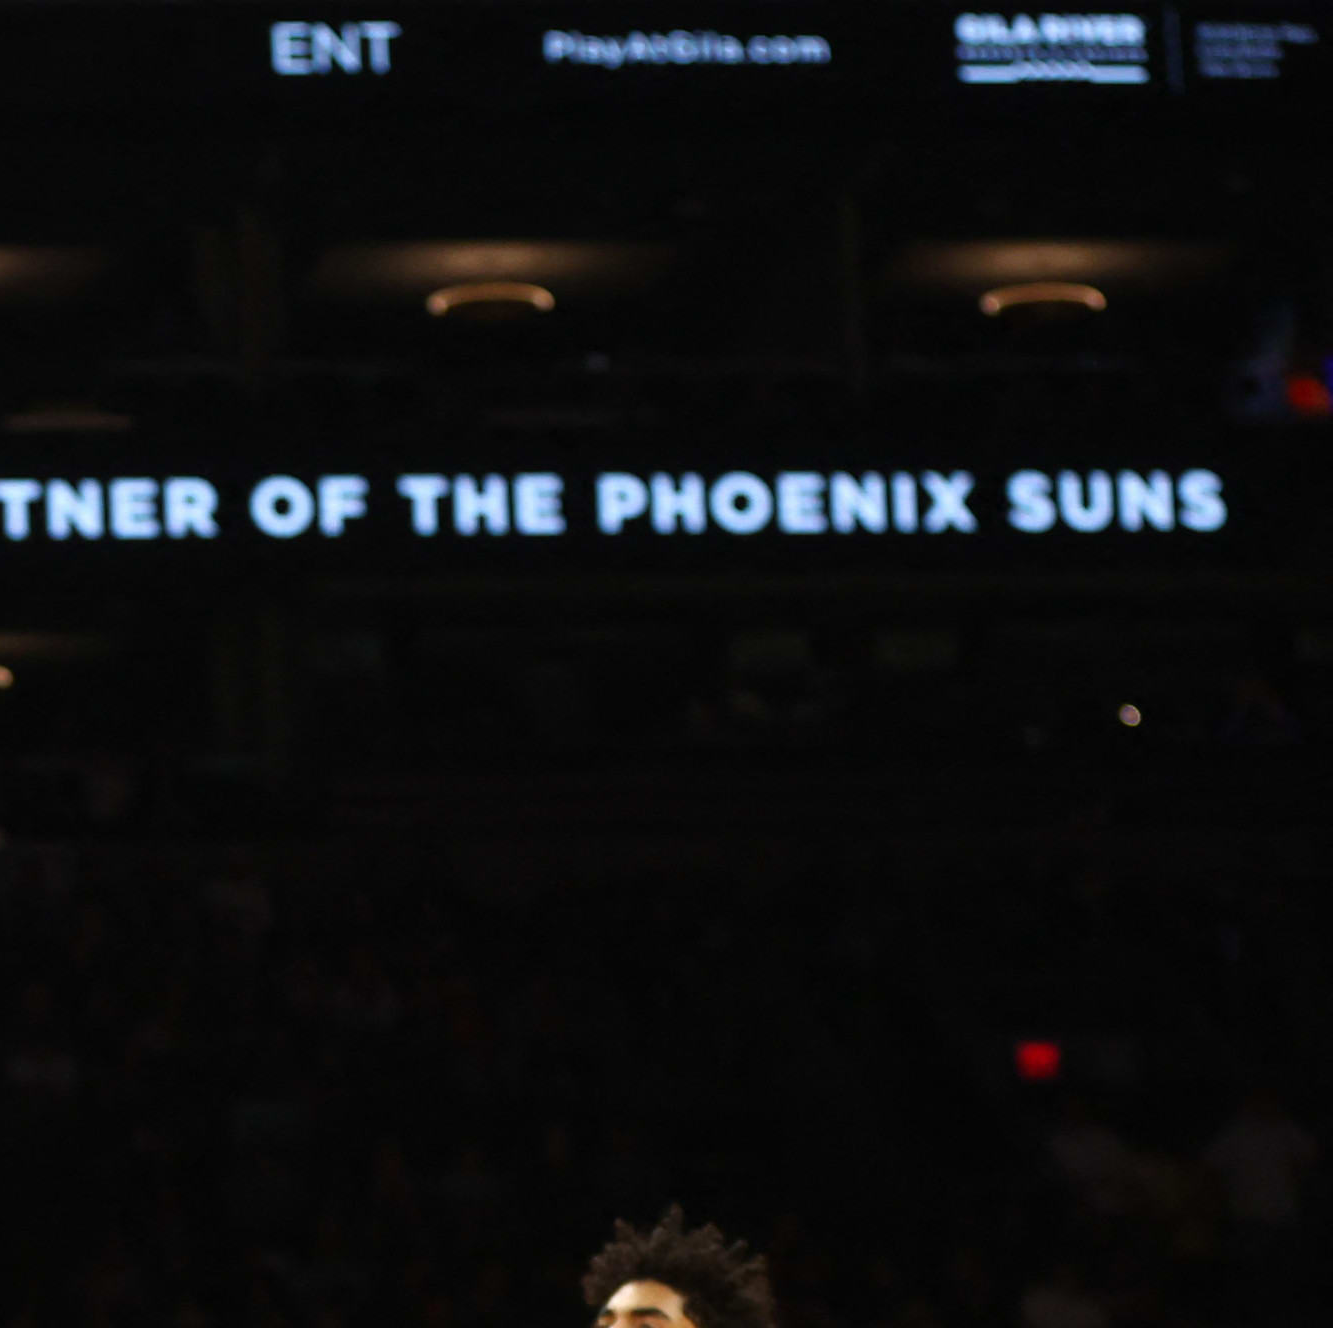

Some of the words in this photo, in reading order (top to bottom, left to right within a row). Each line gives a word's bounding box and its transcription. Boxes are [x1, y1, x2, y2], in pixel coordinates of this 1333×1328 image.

[269, 20, 402, 75] ENT
[249, 474, 369, 539] OF
[396, 472, 567, 537] THE
[595, 470, 978, 536] PHOENIX
[1005, 468, 1229, 533] SUNS
